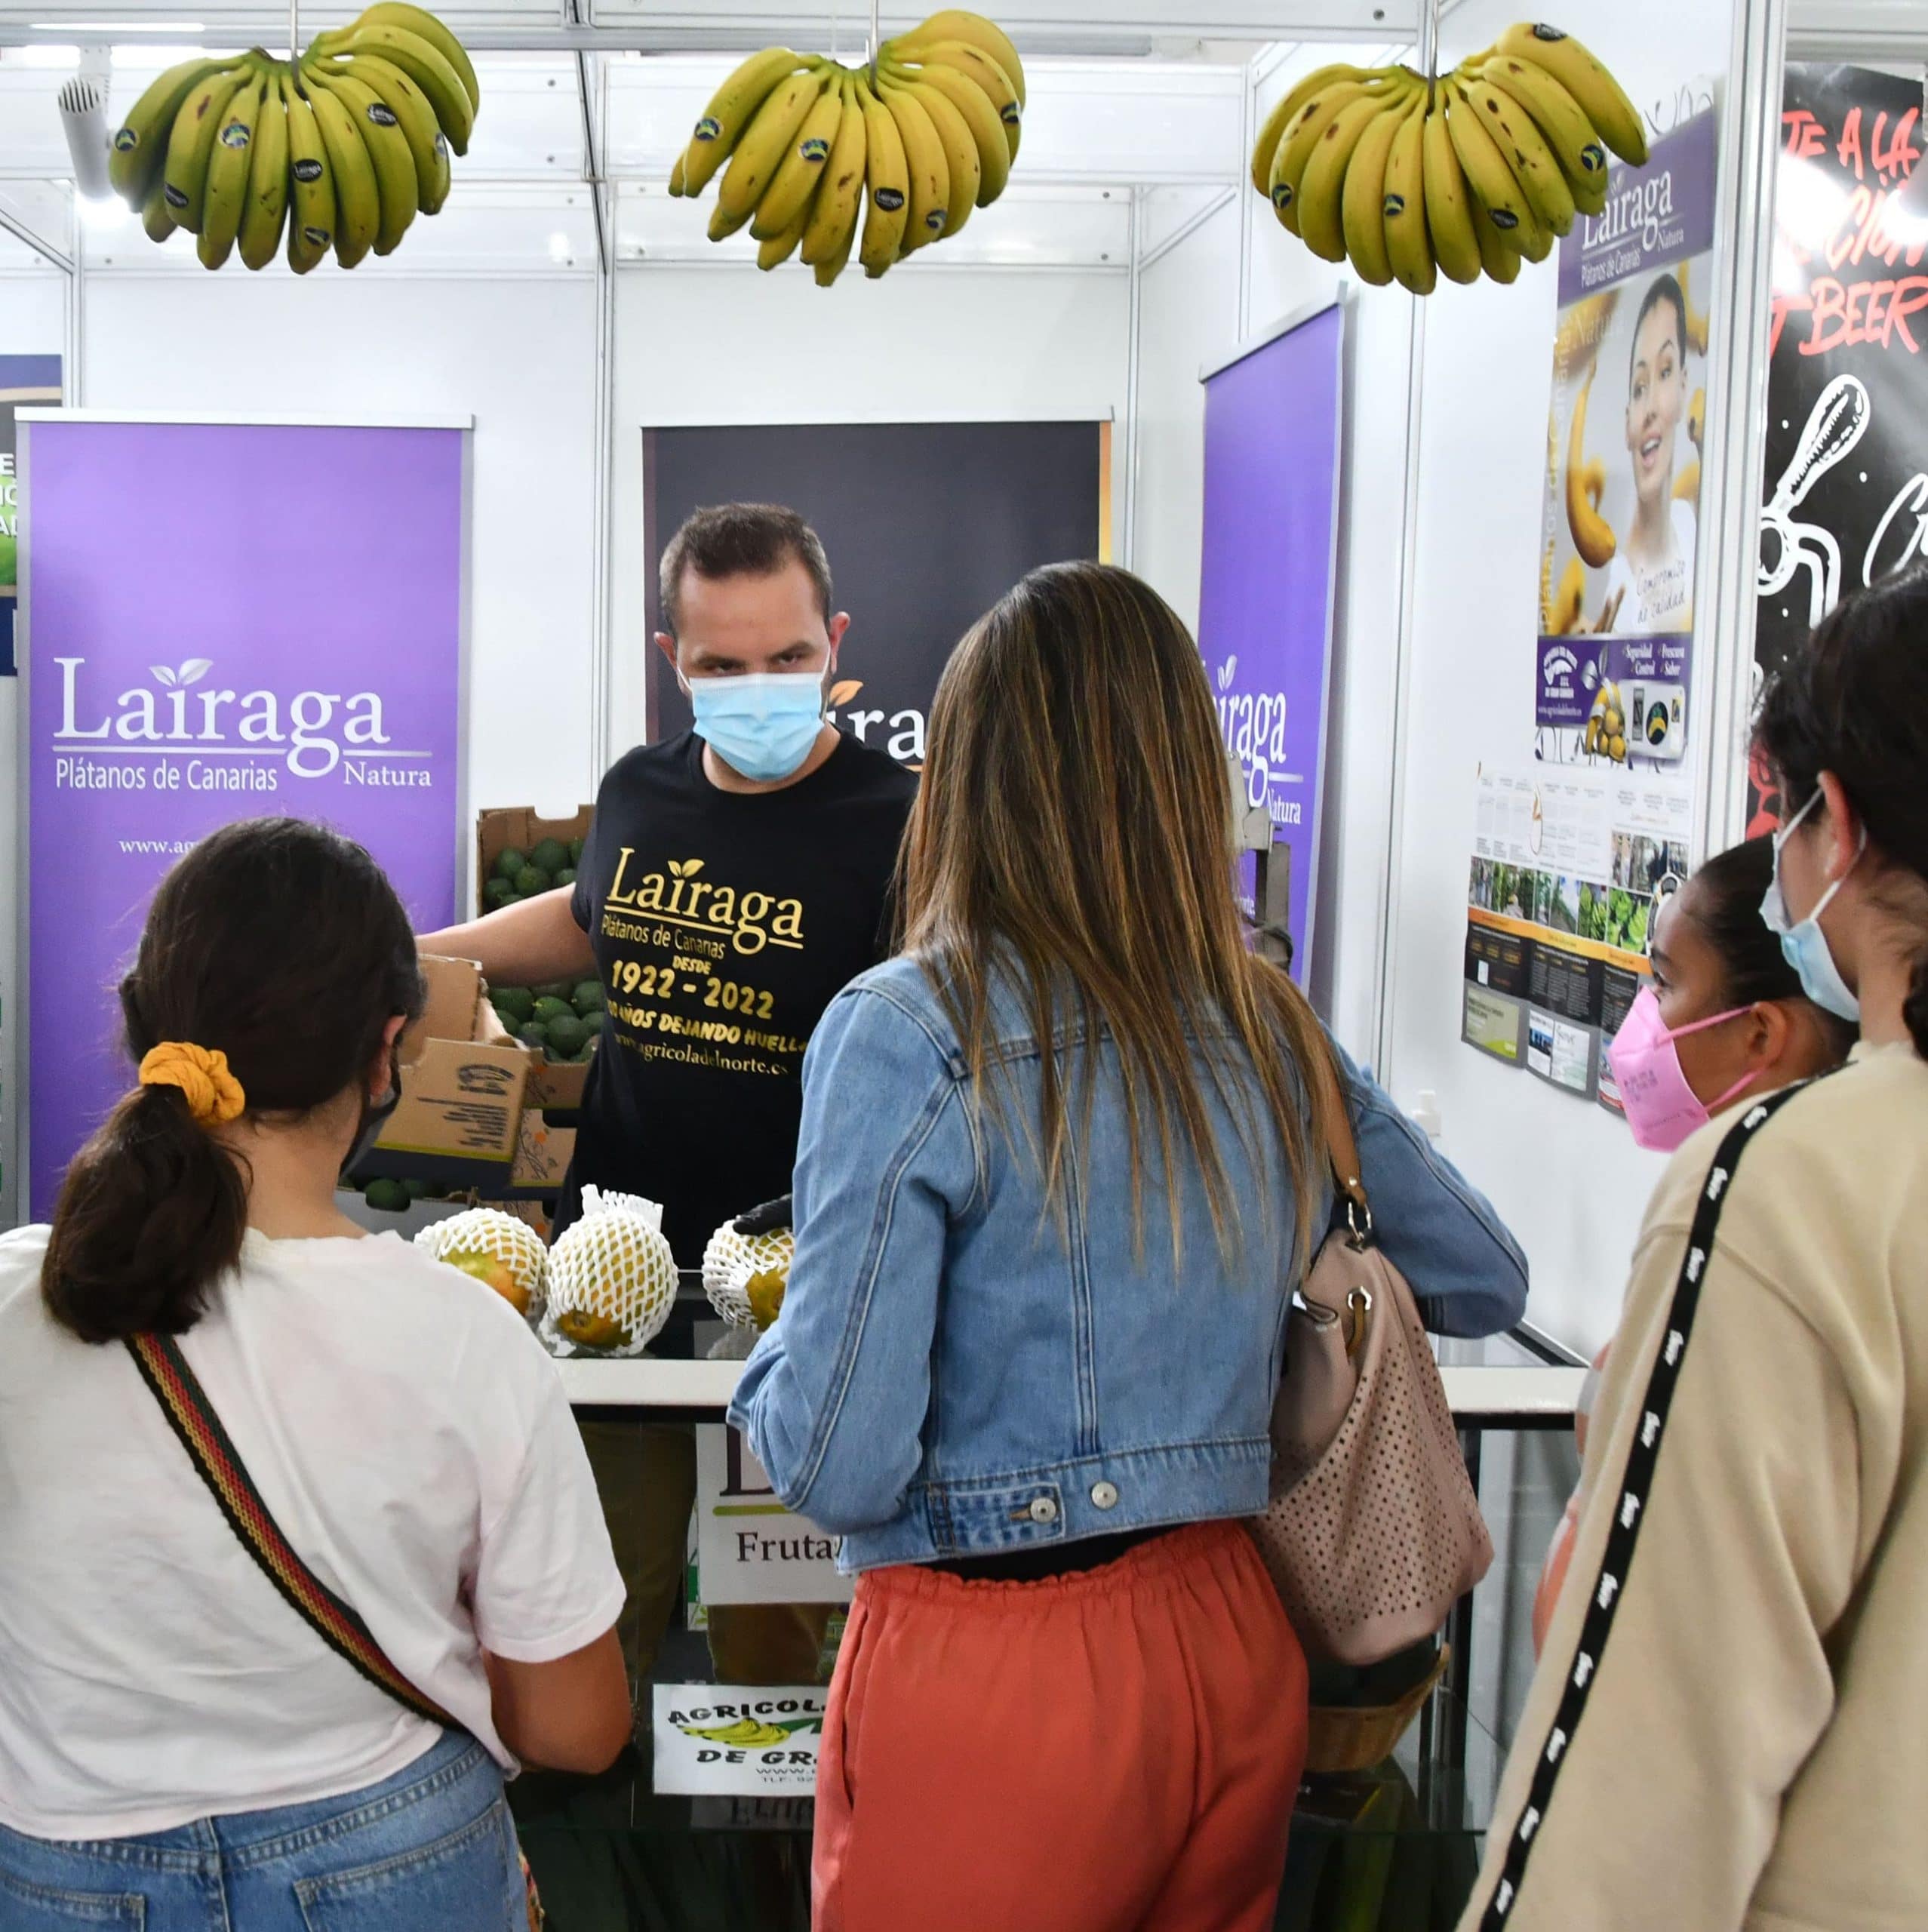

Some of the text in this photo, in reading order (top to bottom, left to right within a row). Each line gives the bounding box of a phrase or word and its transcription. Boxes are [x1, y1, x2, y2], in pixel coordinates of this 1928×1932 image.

[1837, 106, 1864, 181] A
[1871, 107, 1920, 179] LA
[1582, 171, 1673, 252] Lairaga
[1798, 275, 1928, 355] BEER
[53, 657, 391, 778] Lairaga
[1213, 692, 1286, 808] iraga
[57, 758, 277, 791] Plátanos de Canarias
[343, 761, 432, 787] Natura
[606, 847, 804, 955] Lairaga
[601, 914, 649, 943] Plátanos
[653, 924, 671, 948] de
[672, 955, 712, 975] DESDE
[612, 959, 675, 999] 1922
[704, 977, 774, 1020] 2022
[658, 1013, 741, 1044] DEJANDO
[669, 1700, 826, 1724] AGRICOL
[696, 1749, 817, 1765] DE GR
